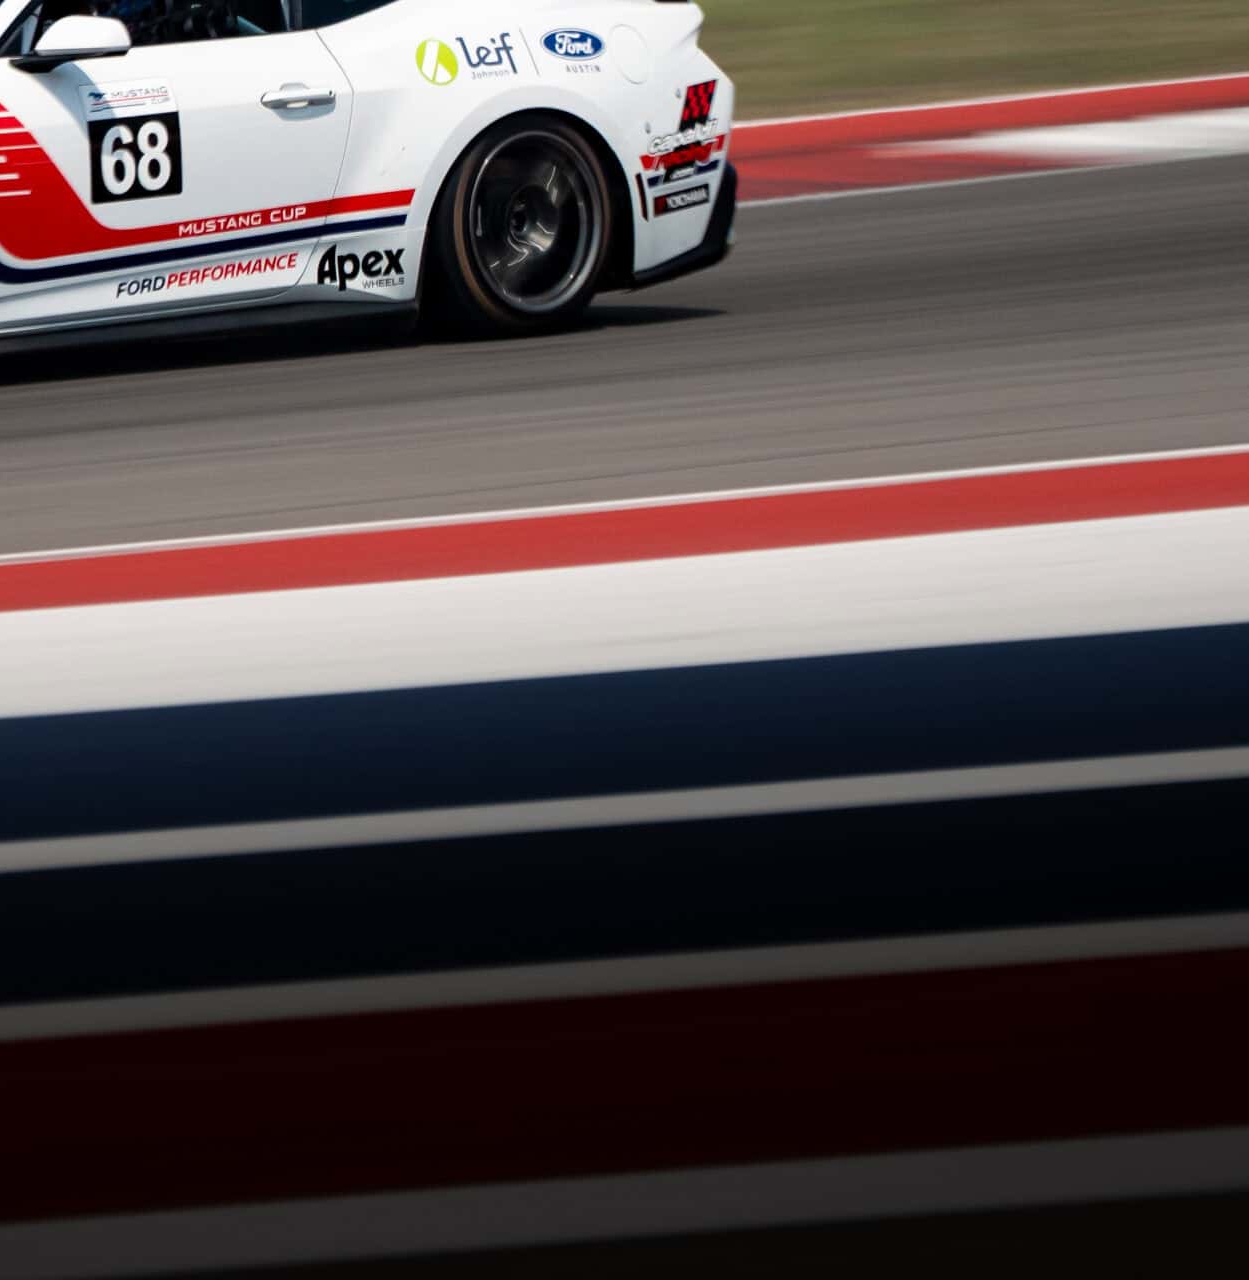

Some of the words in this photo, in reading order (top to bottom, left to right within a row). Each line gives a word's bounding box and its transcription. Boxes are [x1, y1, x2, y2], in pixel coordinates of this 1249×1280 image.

[554, 32, 594, 55] Ford
[471, 69, 511, 80] Johnson
[566, 64, 602, 73] AUSTIN
[111, 86, 168, 97] MUSTANG
[100, 120, 171, 196] 68
[178, 215, 262, 237] MUSTANG
[269, 206, 307, 223] CUP
[317, 244, 406, 292] Apex
[361, 277, 406, 289] WHEELS
